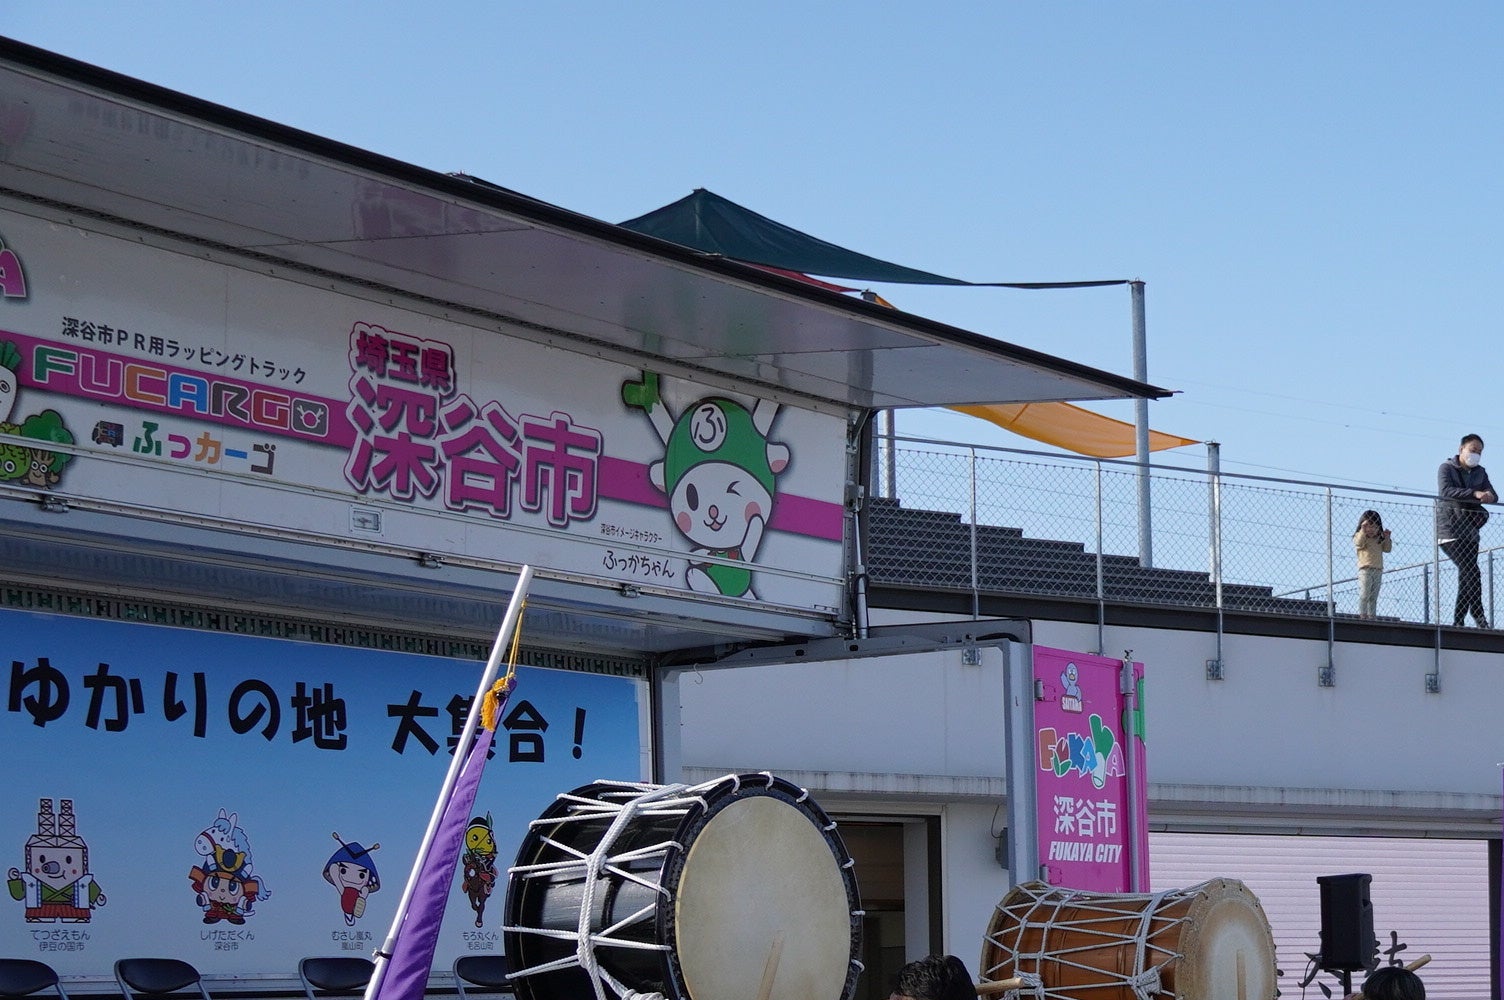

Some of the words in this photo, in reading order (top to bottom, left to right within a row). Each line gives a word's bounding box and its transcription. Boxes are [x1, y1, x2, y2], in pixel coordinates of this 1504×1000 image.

[62, 316, 306, 385] 深谷市PR用ラッピングトラック
[356, 330, 451, 391] 埼玉県
[693, 406, 726, 445] ふ
[133, 421, 277, 475] ふっカーゴ
[350, 375, 600, 521] 深谷市
[602, 550, 675, 578] ふっかちゃん
[7, 657, 349, 752] ゆかりの地
[1038, 713, 1126, 790] FUKAYA
[1054, 795, 1117, 838] 深谷市
[1048, 841, 1094, 863] FUKAYA
[1096, 843, 1123, 864] CITY
[30, 929, 91, 941] てつざえもん
[39, 941, 85, 951] 伊豆の国市
[200, 930, 255, 941] しげただくん
[214, 941, 239, 951] 深谷市
[331, 930, 373, 941] むさし嵐丸
[462, 931, 499, 941] もろ丸くん
